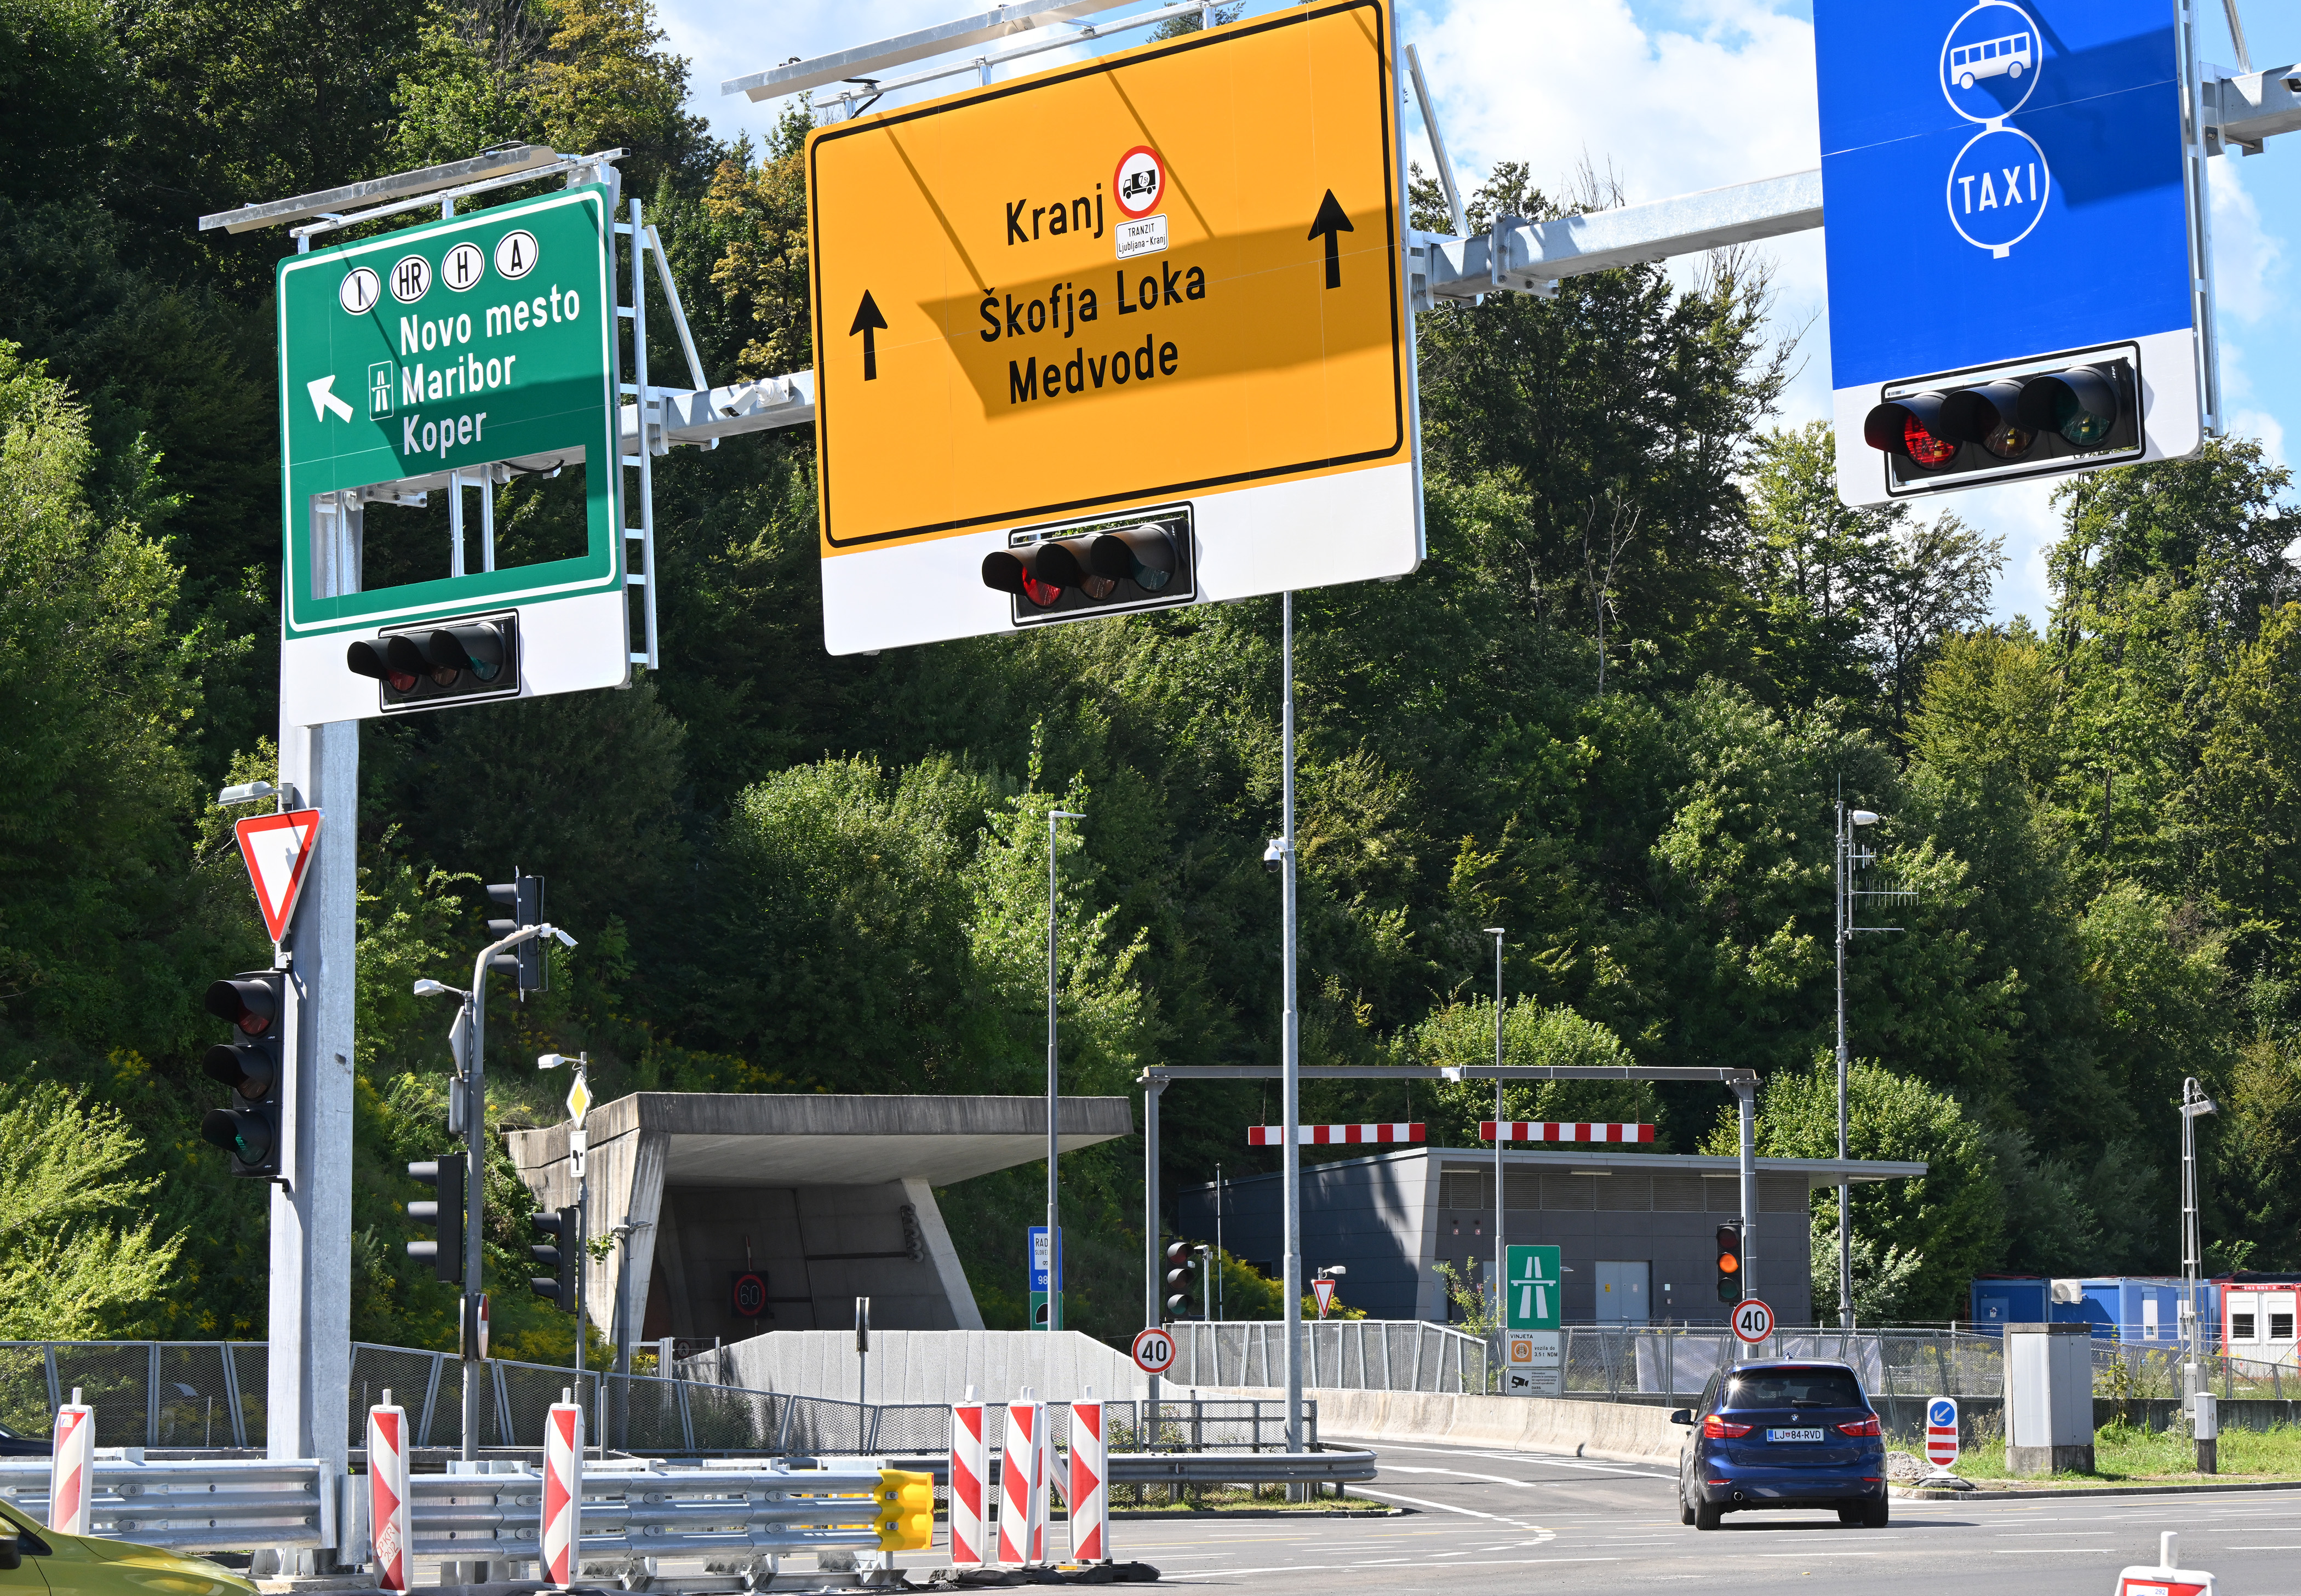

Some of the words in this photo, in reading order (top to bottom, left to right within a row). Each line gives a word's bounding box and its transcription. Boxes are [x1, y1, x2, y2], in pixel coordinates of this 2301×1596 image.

[1958, 163, 2036, 214] TAXI
[1006, 182, 1103, 245] Kranj
[1119, 239, 1145, 254] Ljubljana
[1150, 234, 1165, 245] Kranj
[1128, 223, 1154, 237] TRANZIT
[457, 251, 468, 283] H
[511, 239, 523, 271] A
[357, 276, 362, 306] I
[399, 262, 422, 297] HR
[980, 282, 1097, 342] Škofja
[1117, 260, 1206, 315] Loka
[401, 313, 471, 356] Novo
[486, 283, 580, 337] mesto
[402, 352, 516, 406] Maribor
[1009, 334, 1178, 404] Medvode
[404, 411, 486, 459] Koper
[1035, 1238, 1048, 1247] RAD
[740, 1285, 759, 1305] 60
[1038, 1275, 1048, 1285] 98
[1741, 1311, 1765, 1331] 40
[1142, 1340, 1167, 1362] 40
[1775, 1431, 1784, 1439] LJ
[1791, 1431, 1821, 1439] 84-RVD
[385, 1542, 399, 1563] 292
